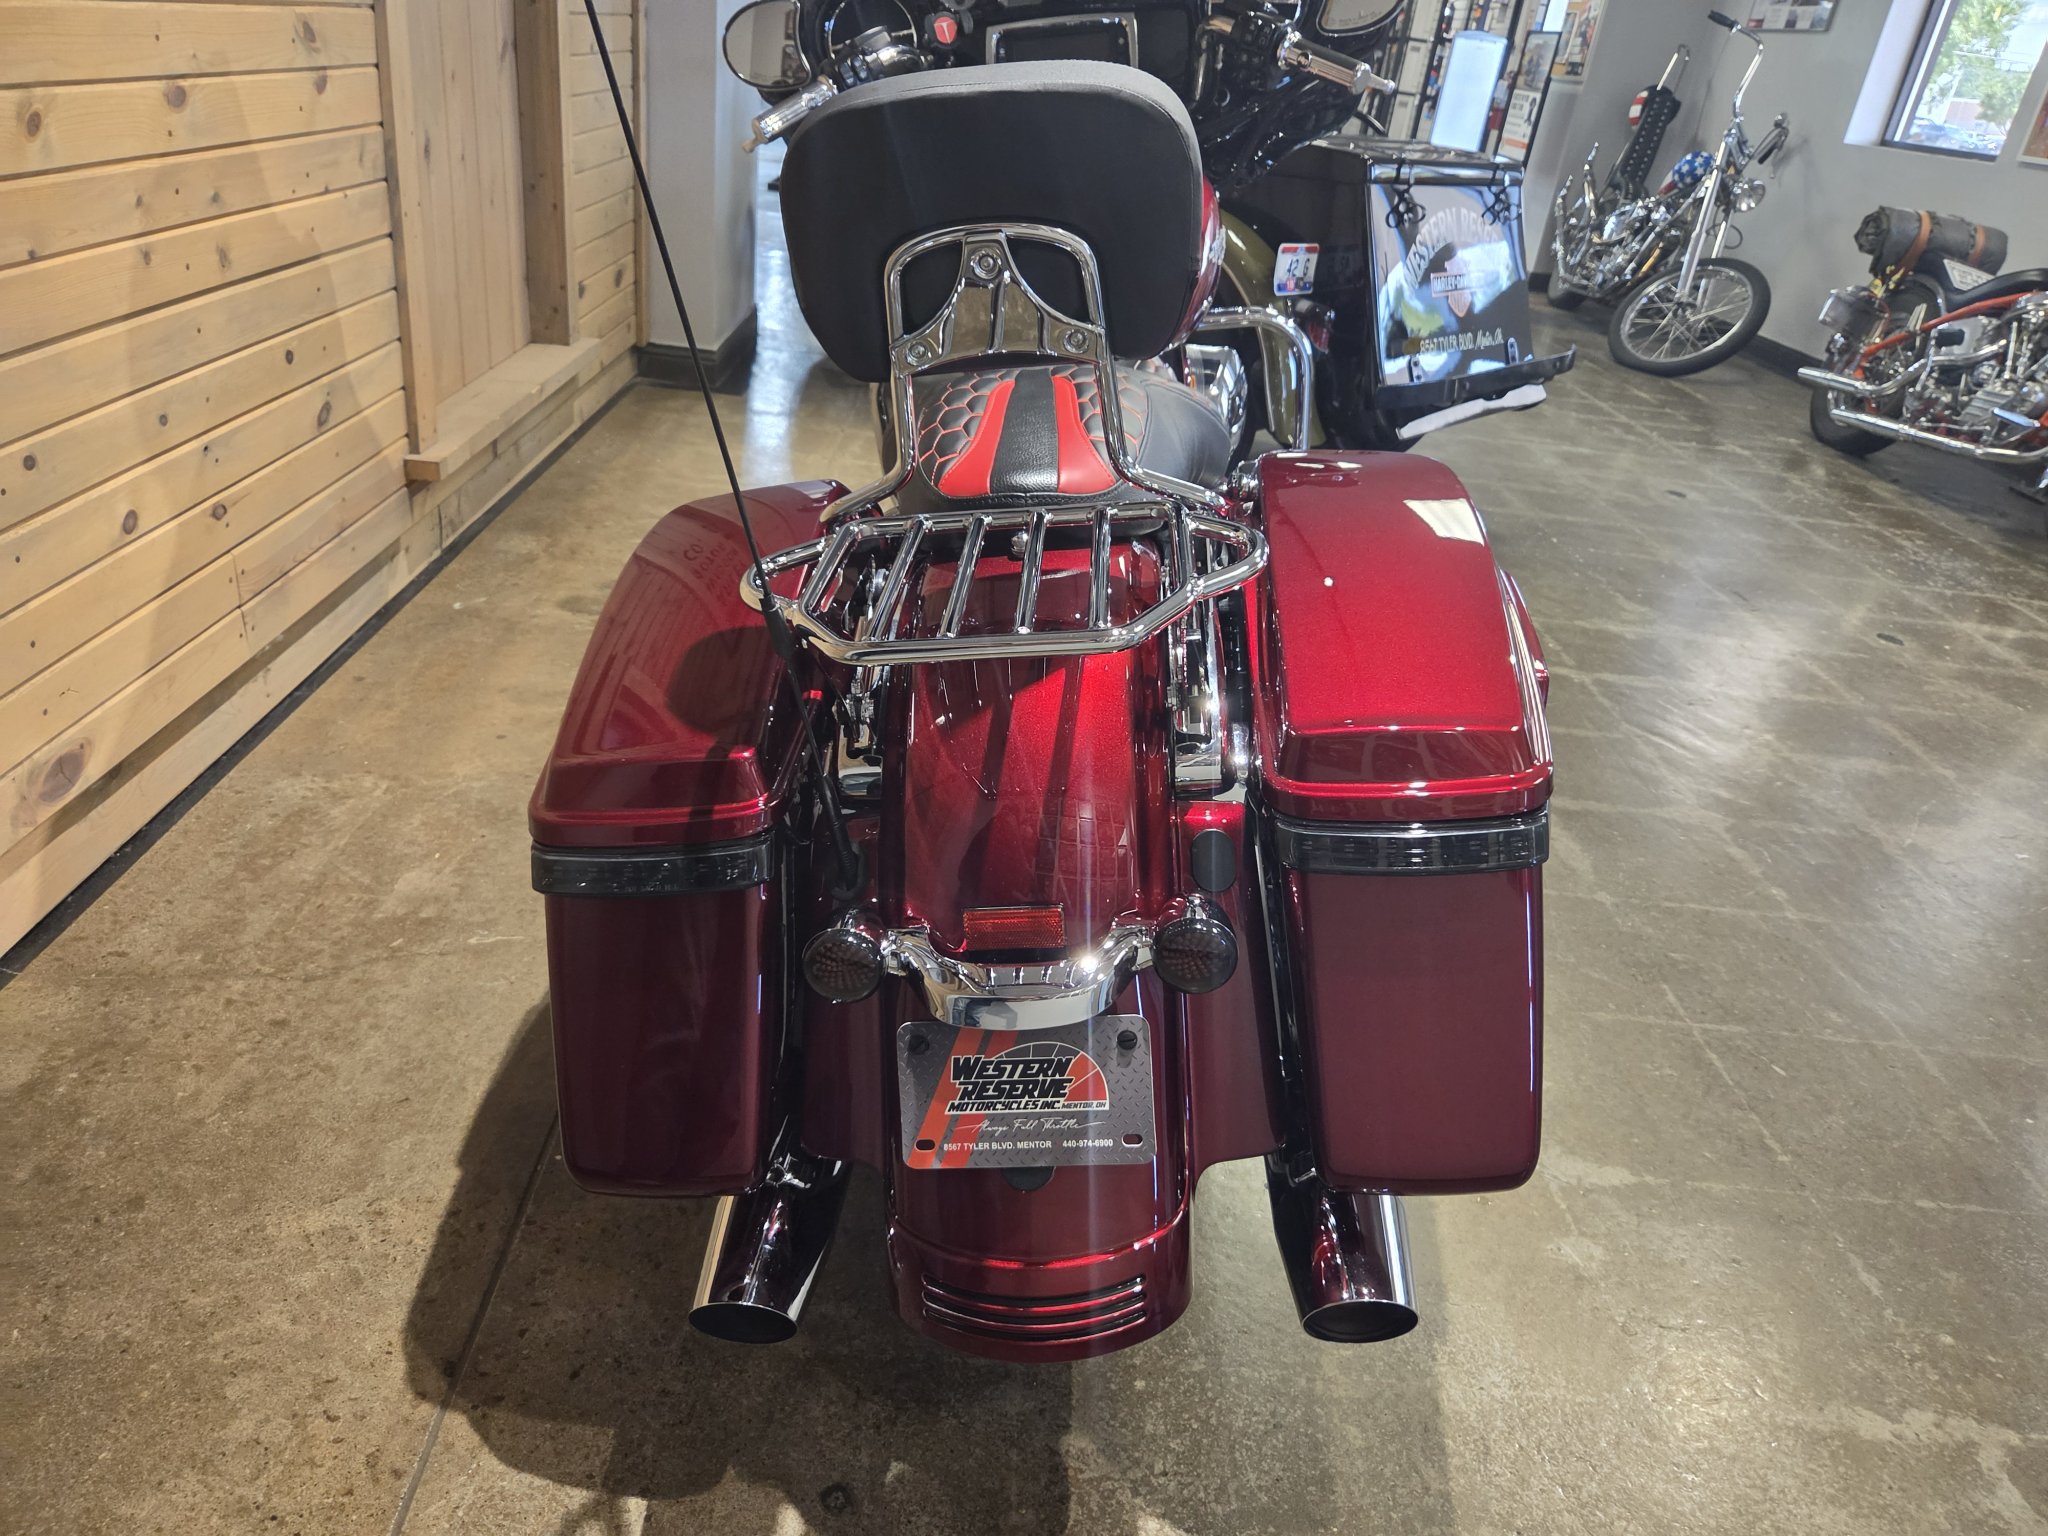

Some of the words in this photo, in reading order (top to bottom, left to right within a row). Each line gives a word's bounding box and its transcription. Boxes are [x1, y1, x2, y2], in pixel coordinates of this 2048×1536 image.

[1404, 207, 1457, 289] WESTERN
[1439, 335, 1458, 353] TYLER
[952, 1056, 1074, 1081] WESTERN
[957, 1078, 1074, 1100] RESERVE
[947, 1100, 1039, 1113] MOTORCYCLES
[1039, 1100, 1060, 1110] INC.
[960, 1119, 1009, 1136] Always
[1013, 1119, 1038, 1132] Full
[1040, 1117, 1094, 1132] Throttle
[943, 1143, 961, 1151] 8567
[963, 1142, 990, 1150] TYLER
[991, 1141, 1015, 1150] BLVD.
[1017, 1140, 1052, 1149] MENTOR
[1062, 1138, 1113, 1148] 440-974-6900
